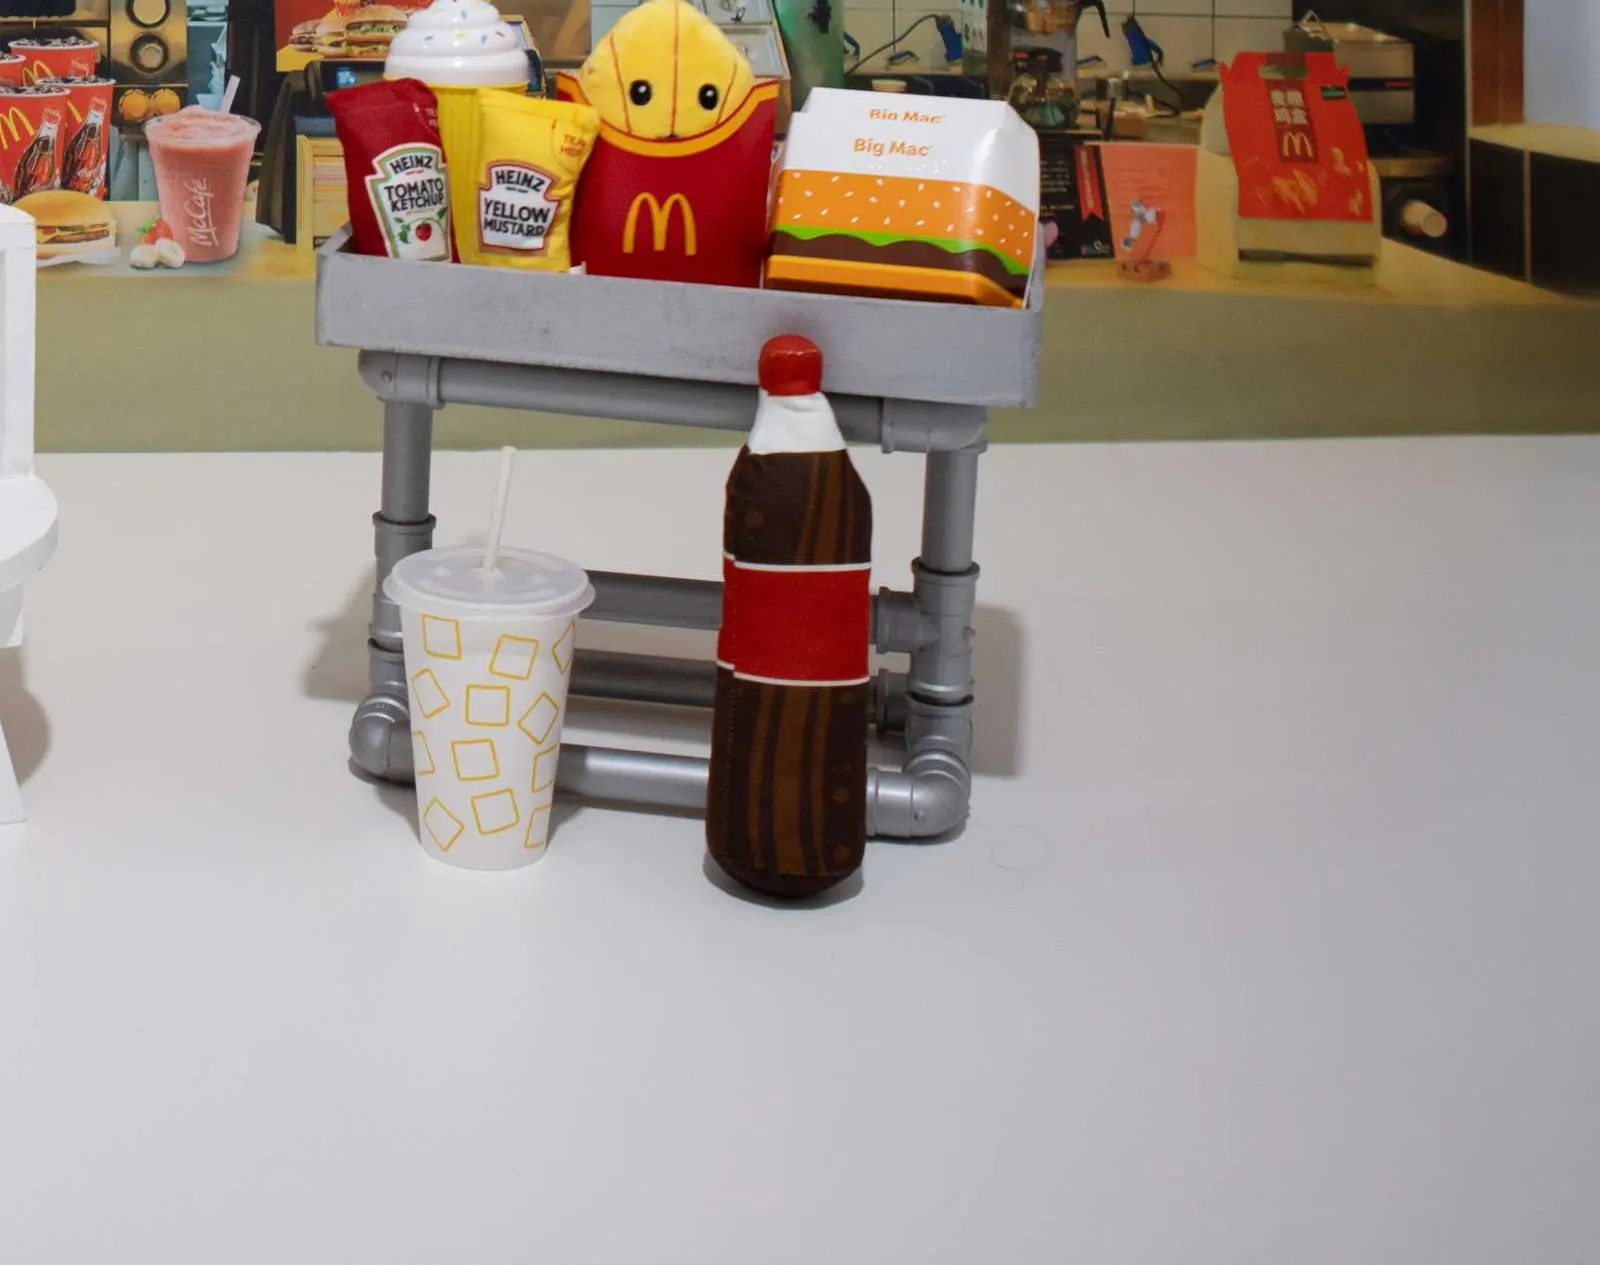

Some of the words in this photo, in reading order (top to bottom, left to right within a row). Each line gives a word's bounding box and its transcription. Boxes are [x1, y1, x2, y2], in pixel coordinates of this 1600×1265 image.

[903, 111, 942, 124] Mac
[853, 137, 884, 157] Big
[889, 140, 930, 157] Mac
[390, 155, 433, 174] HEINZ
[384, 178, 444, 201] TOMATO
[495, 169, 546, 192] HEINZ
[391, 193, 444, 212] KETCHUP
[484, 197, 550, 223] YELLOW
[483, 217, 545, 237] MUSTARD
